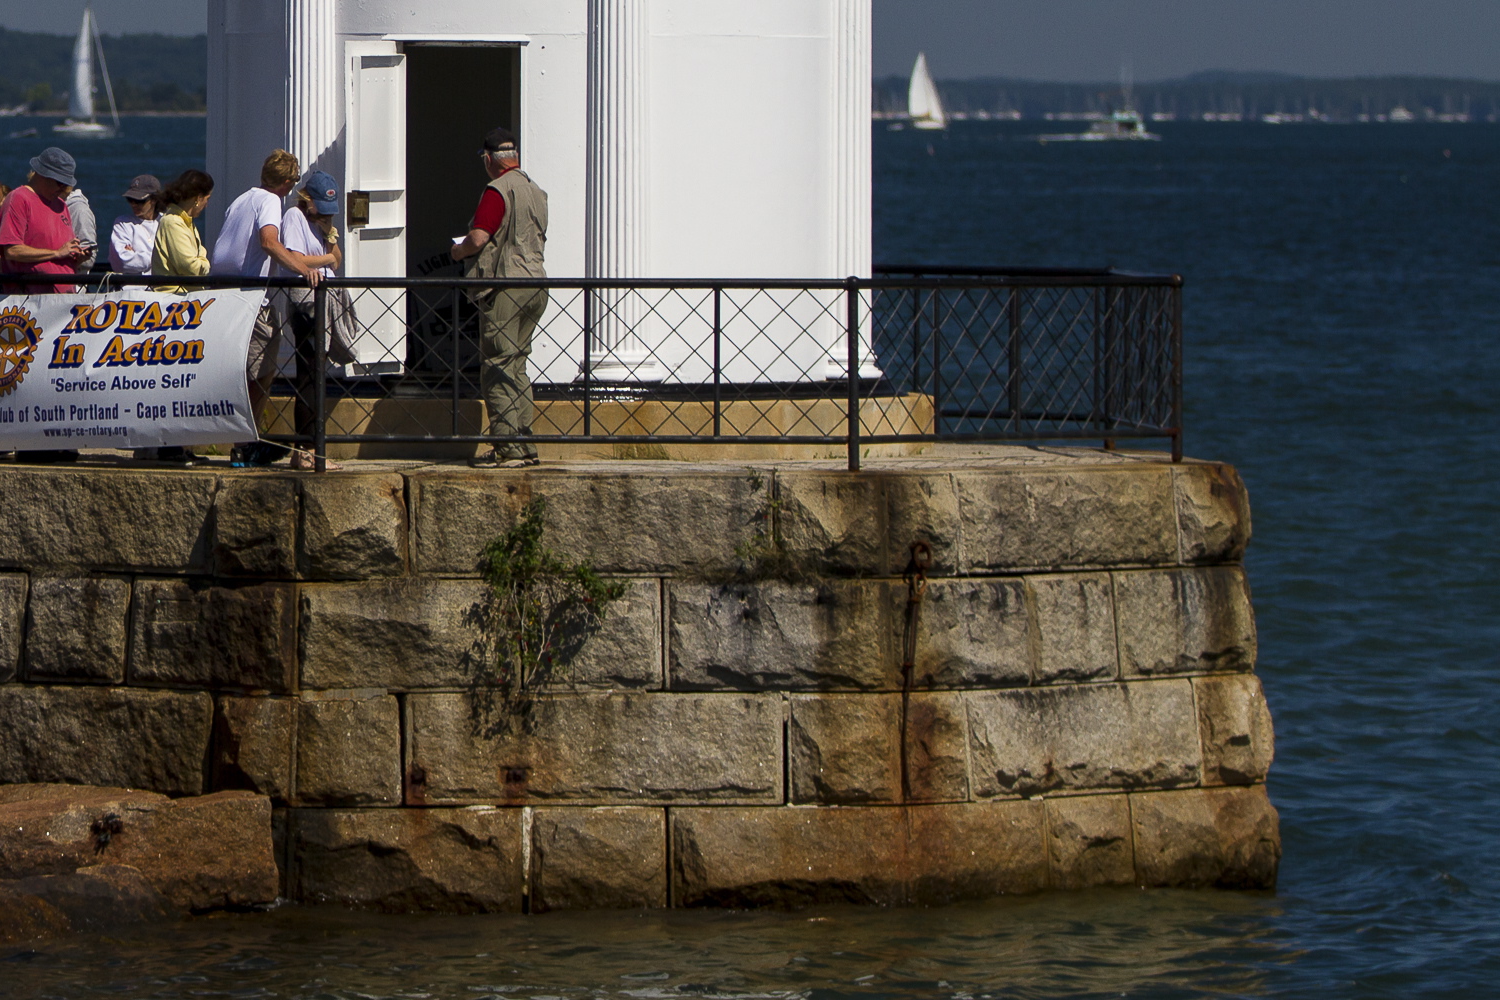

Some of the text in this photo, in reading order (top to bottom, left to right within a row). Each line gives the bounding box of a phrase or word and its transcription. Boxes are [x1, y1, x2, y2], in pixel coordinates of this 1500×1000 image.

[60, 298, 216, 334] ROTARY
[48, 334, 205, 369] In Action
[51, 373, 196, 392] "Service Above Self"
[19, 406, 29, 422] of
[34, 405, 65, 421] South
[70, 403, 118, 420] Portland
[137, 402, 166, 421] Cape
[172, 400, 235, 417] Elizabeth
[43, 425, 127, 438] www.sp-ce-rotary.org
